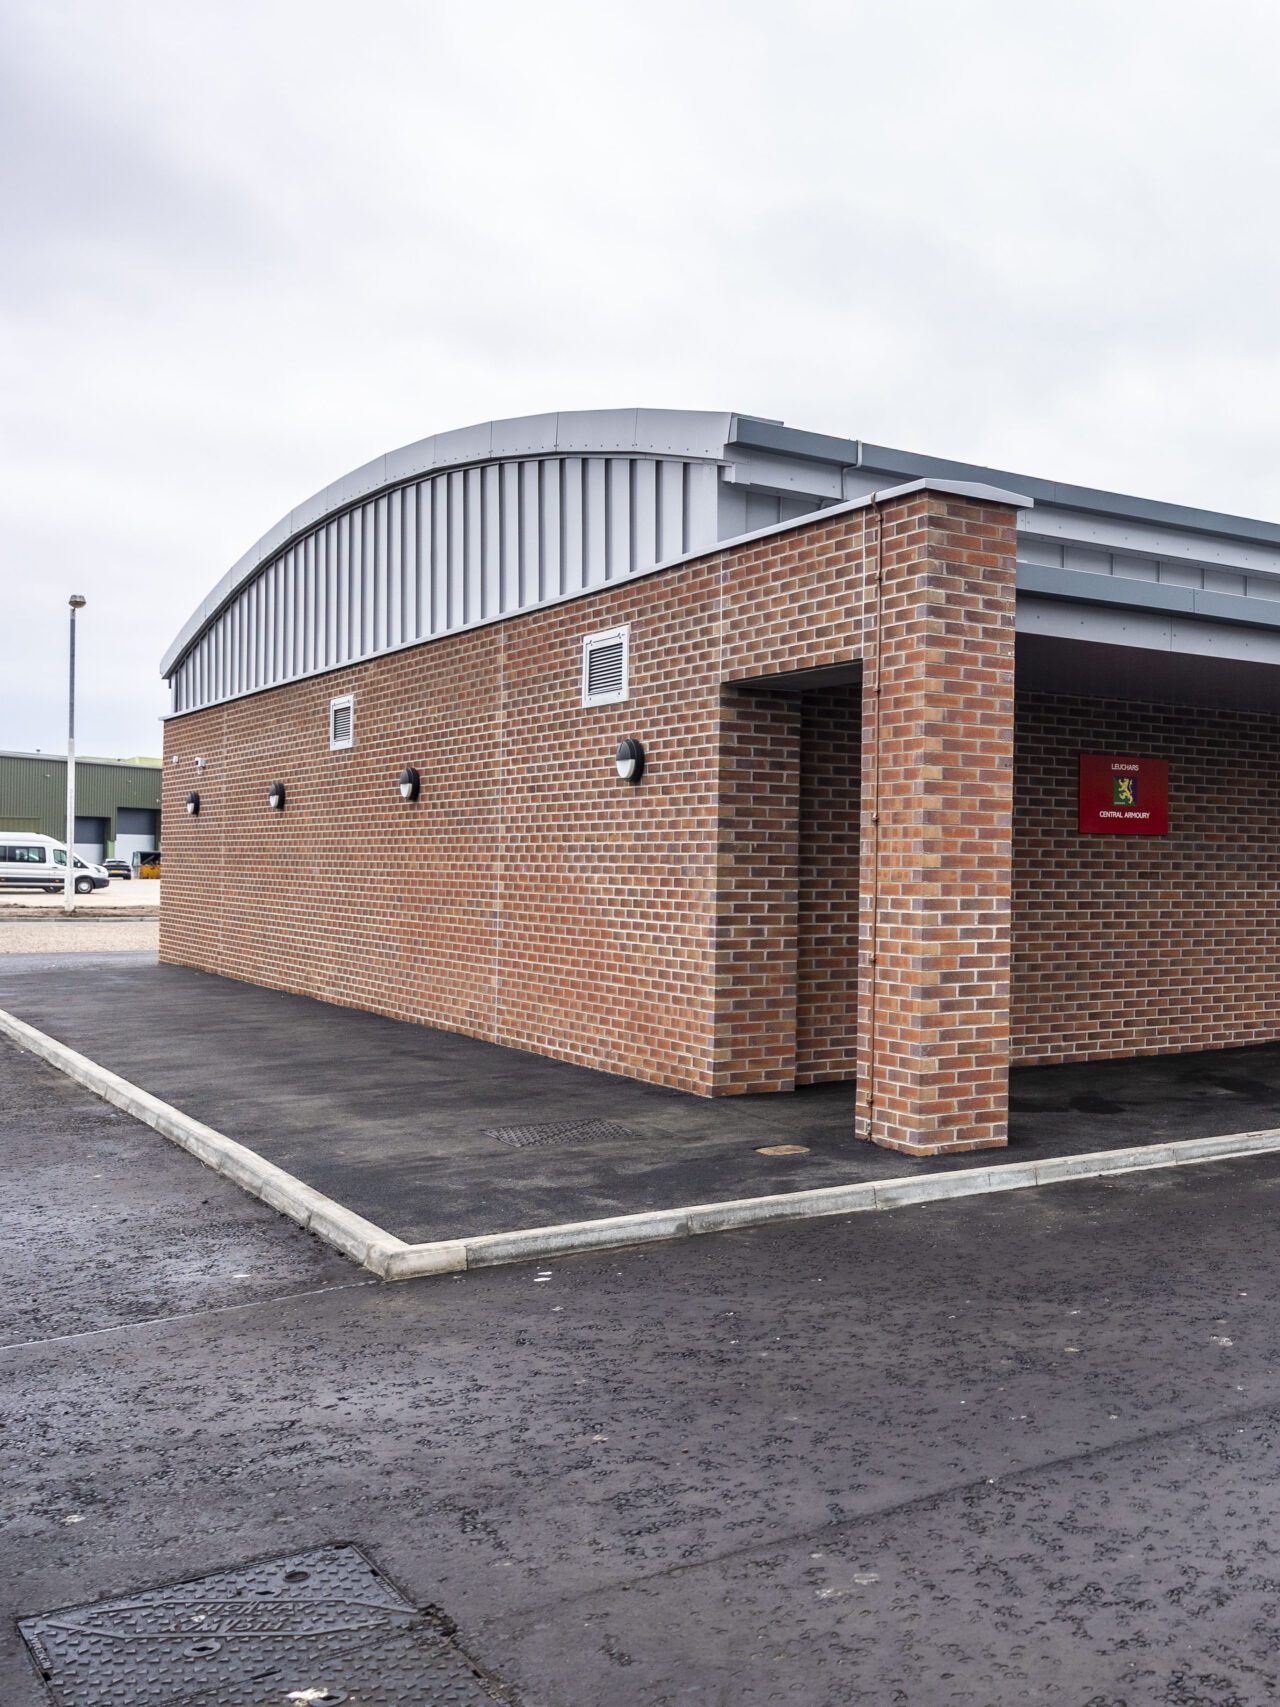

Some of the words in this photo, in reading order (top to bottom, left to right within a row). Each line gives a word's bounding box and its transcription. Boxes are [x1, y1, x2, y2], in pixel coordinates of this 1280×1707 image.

[1111, 763, 1139, 771] LEUCHARS
[1099, 810, 1123, 818] CENTRAL
[1124, 811, 1150, 819] ARMOURY
[195, 1600, 312, 1614] HIGHWAY
[160, 1618, 284, 1632] HIGHWAY
